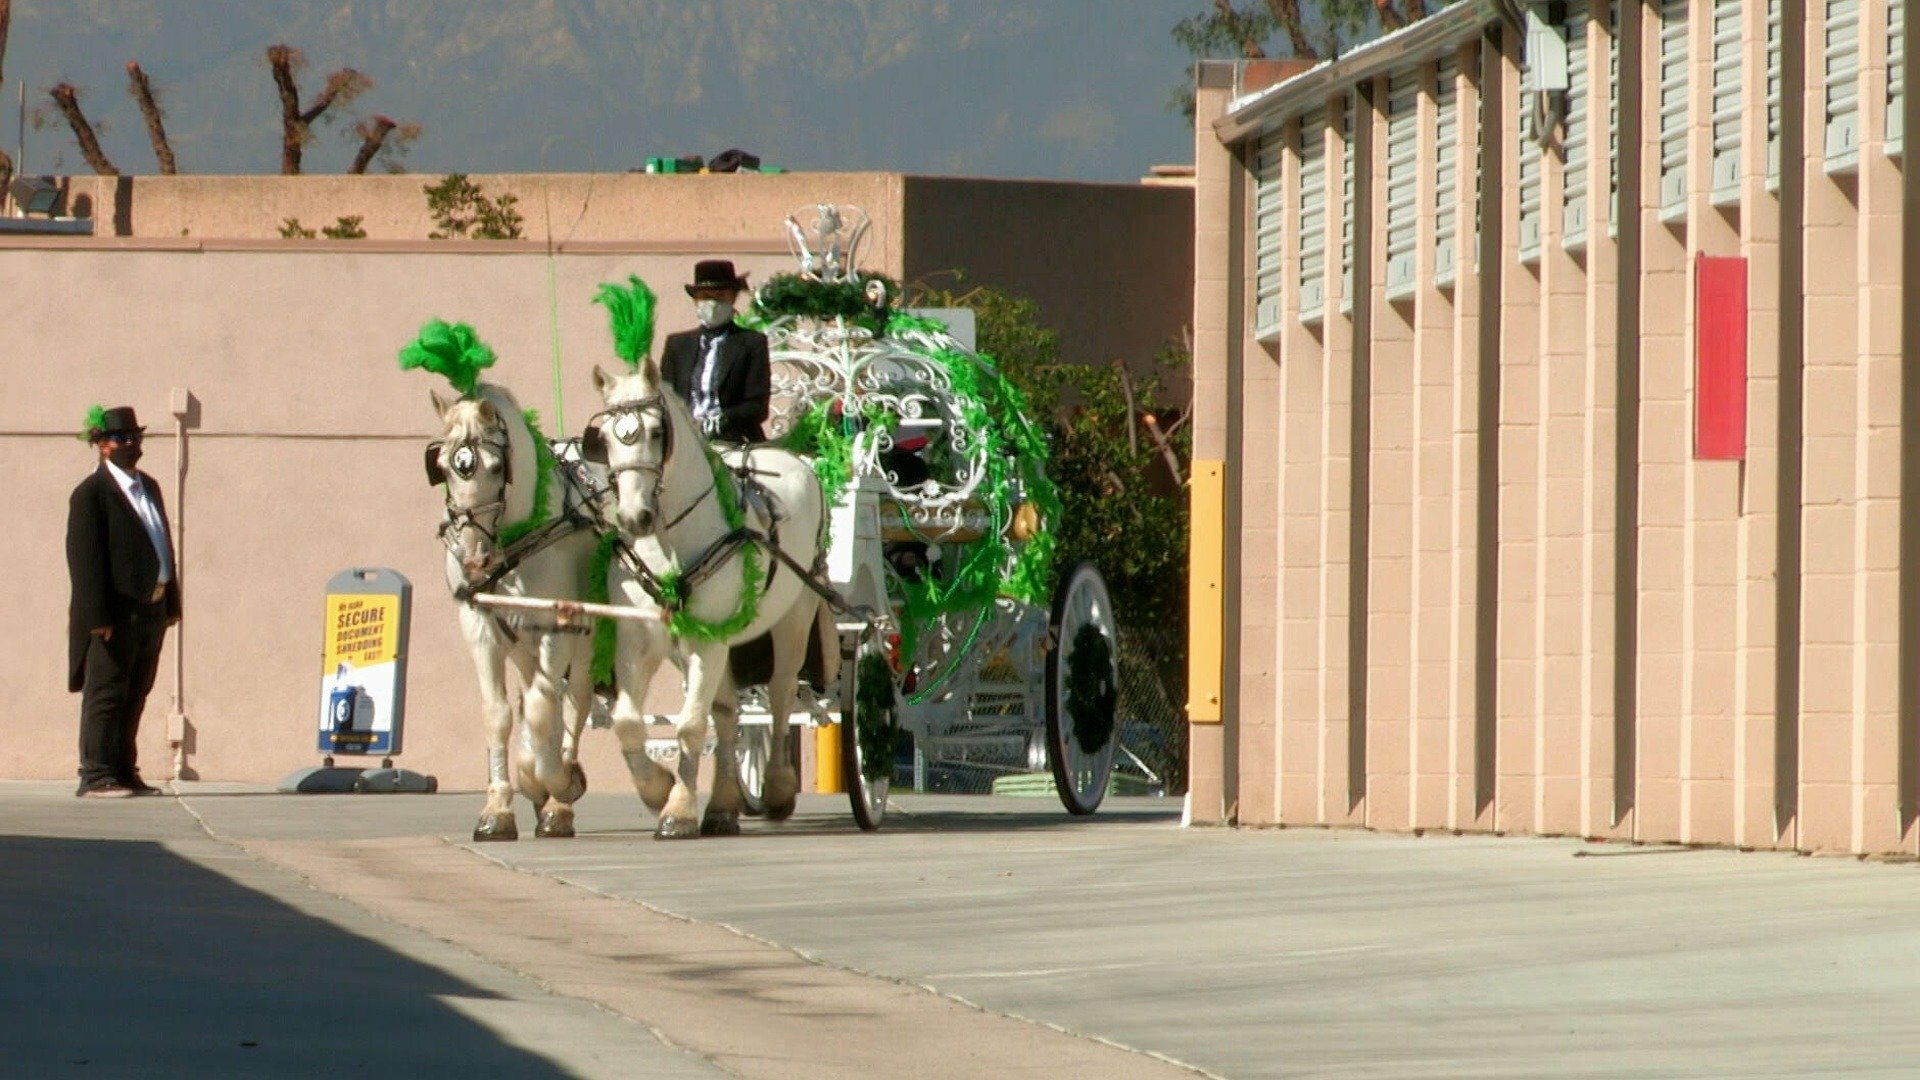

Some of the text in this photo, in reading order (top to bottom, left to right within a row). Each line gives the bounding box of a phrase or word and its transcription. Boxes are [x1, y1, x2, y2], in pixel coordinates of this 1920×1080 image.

[337, 607, 385, 628] SECURE
[337, 624, 384, 642] DOCUMENT
[337, 637, 383, 655] SHREDDING
